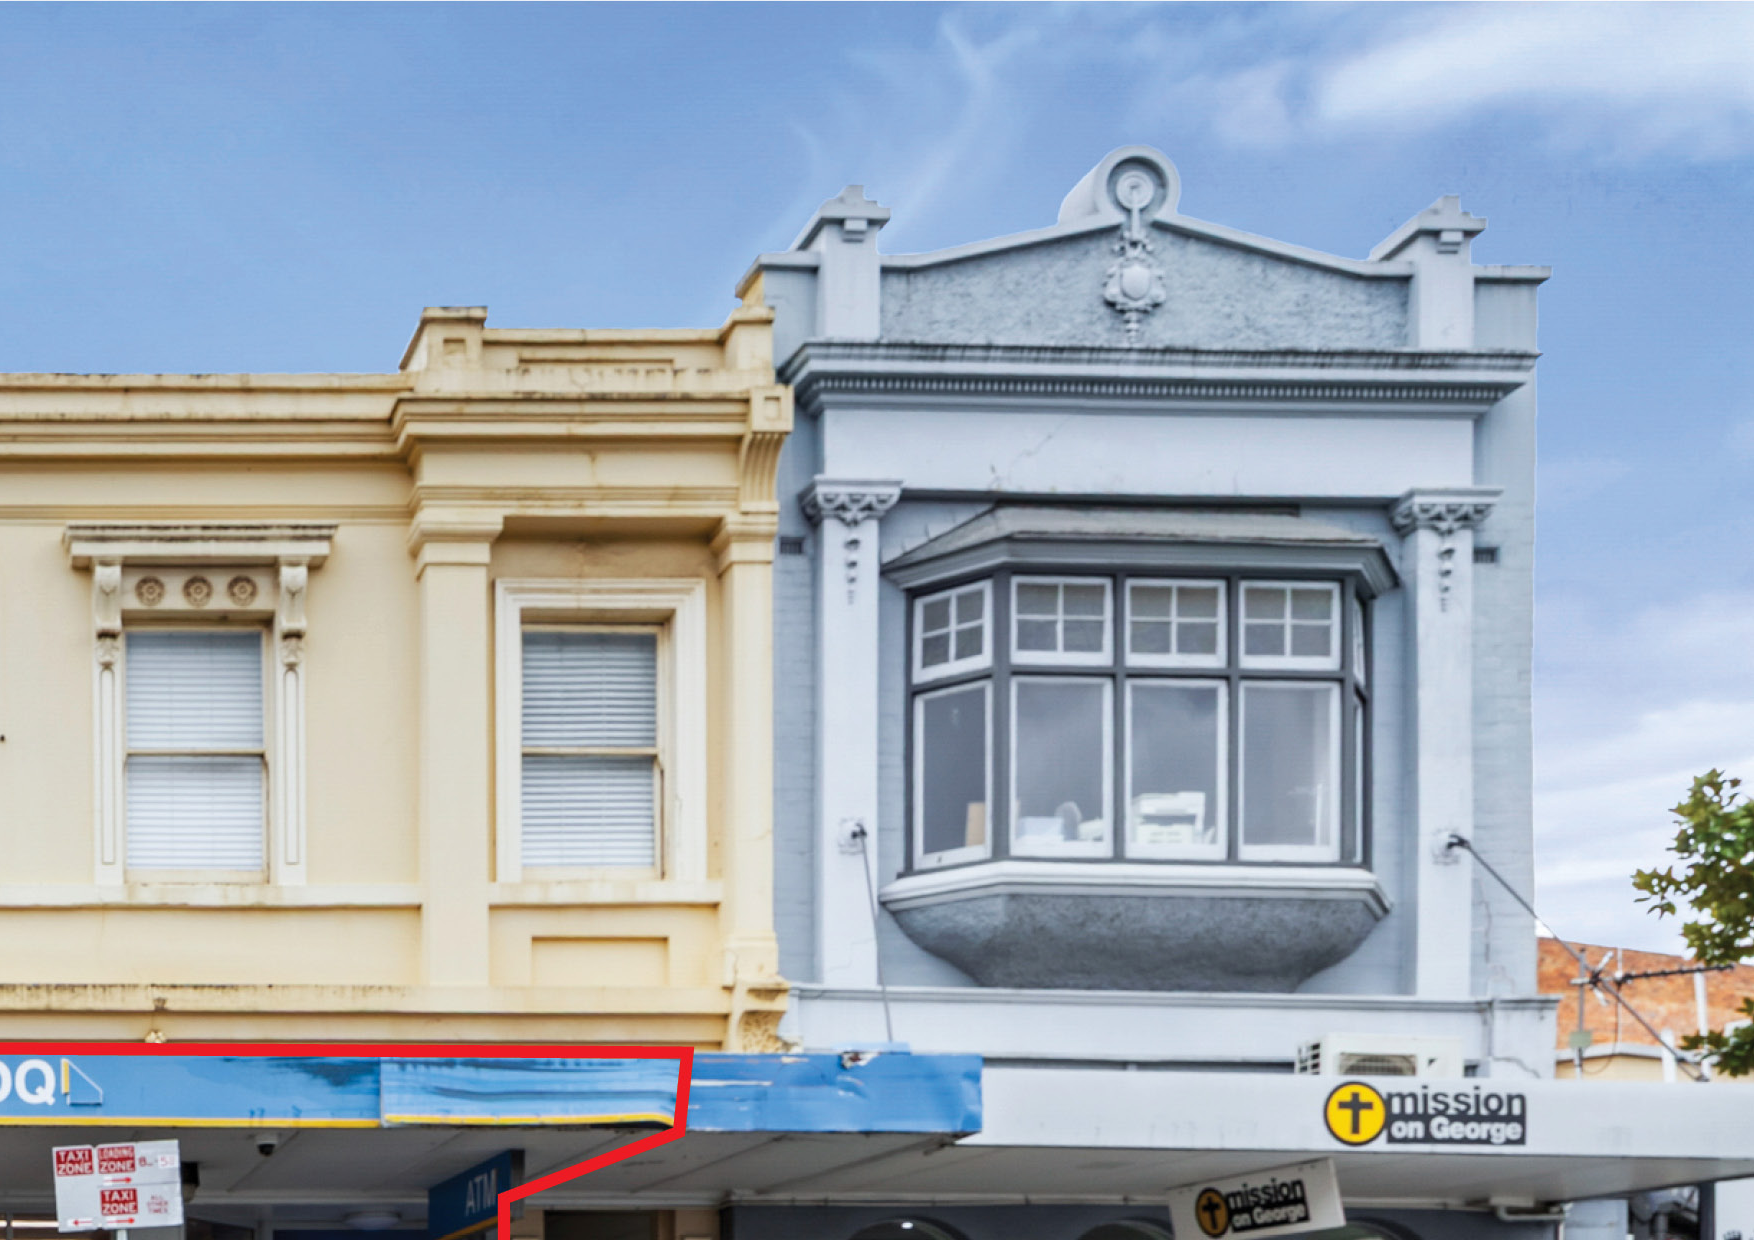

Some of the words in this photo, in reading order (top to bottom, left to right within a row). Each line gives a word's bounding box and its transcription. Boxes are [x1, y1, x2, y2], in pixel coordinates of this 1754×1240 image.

[1386, 1085, 1526, 1116] mission
[1391, 1120, 1425, 1139] on
[1429, 1116, 1523, 1144] George
[58, 1150, 90, 1163] TAXI
[100, 1160, 134, 1173] ZONE
[58, 1161, 92, 1175] ZONE
[104, 1190, 134, 1202] TAXI
[465, 1168, 498, 1217] ATM
[1226, 1177, 1305, 1209] mission
[102, 1202, 137, 1214] ZONE
[1232, 1212, 1252, 1229] on
[1252, 1203, 1306, 1225] George
